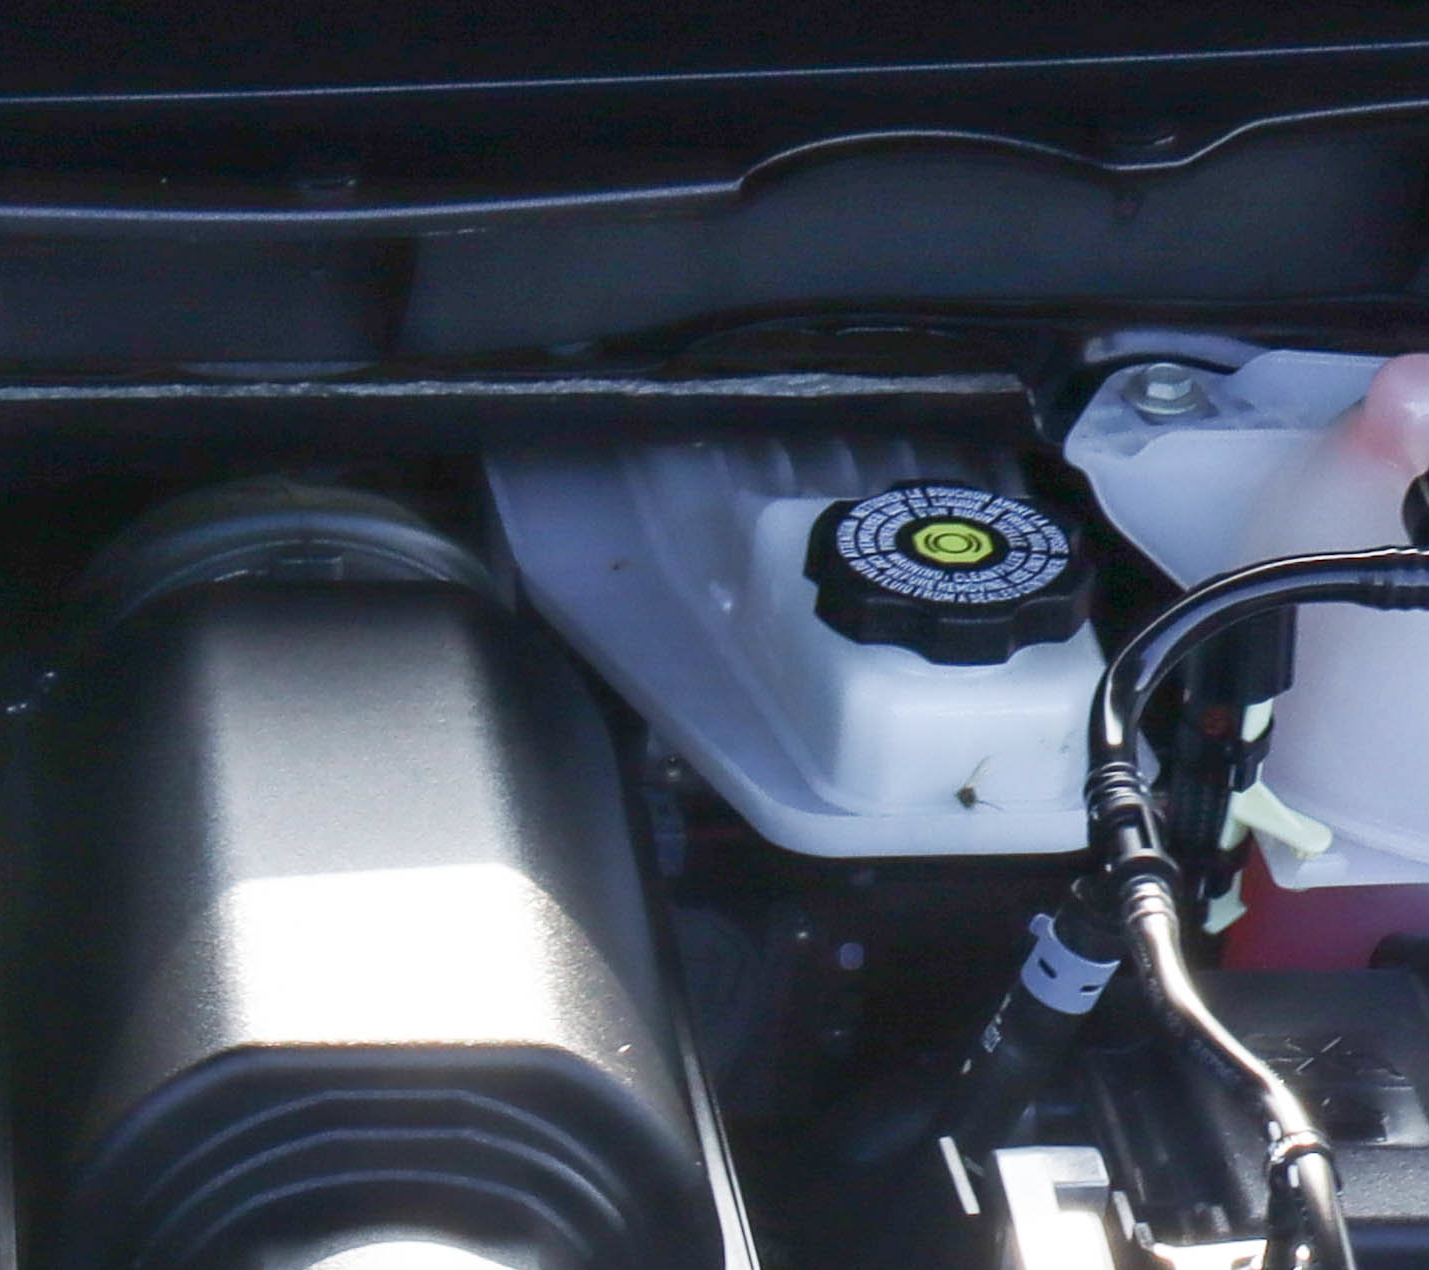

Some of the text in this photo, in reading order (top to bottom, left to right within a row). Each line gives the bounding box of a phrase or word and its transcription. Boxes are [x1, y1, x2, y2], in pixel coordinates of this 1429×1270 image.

[927, 485, 992, 502] BOUCHON
[992, 497, 1036, 516] AVANT
[1030, 514, 1049, 526] LA
[874, 574, 914, 594] FLUID
[913, 588, 955, 602] FROM
